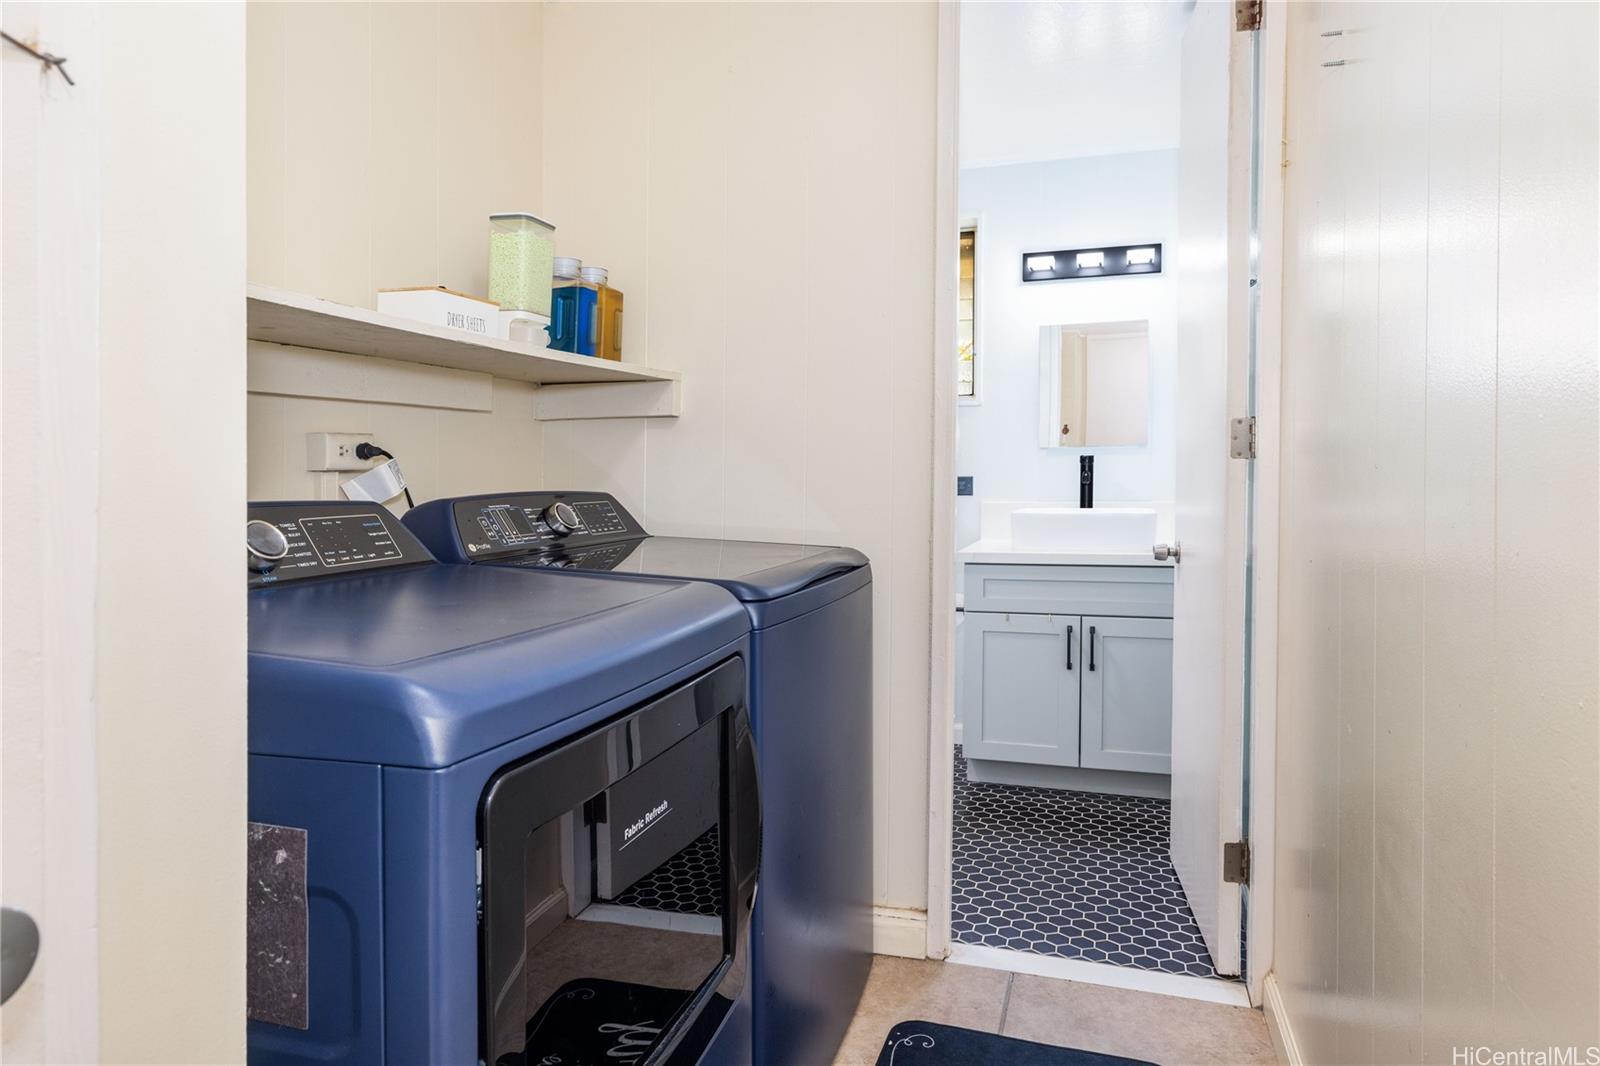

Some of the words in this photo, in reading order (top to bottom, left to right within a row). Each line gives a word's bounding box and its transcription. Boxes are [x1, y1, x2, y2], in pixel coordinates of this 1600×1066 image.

[447, 312, 465, 328] DRYER
[466, 315, 486, 333] SHEETS
[624, 819, 645, 840] Fabric
[645, 799, 668, 824] Refresh
